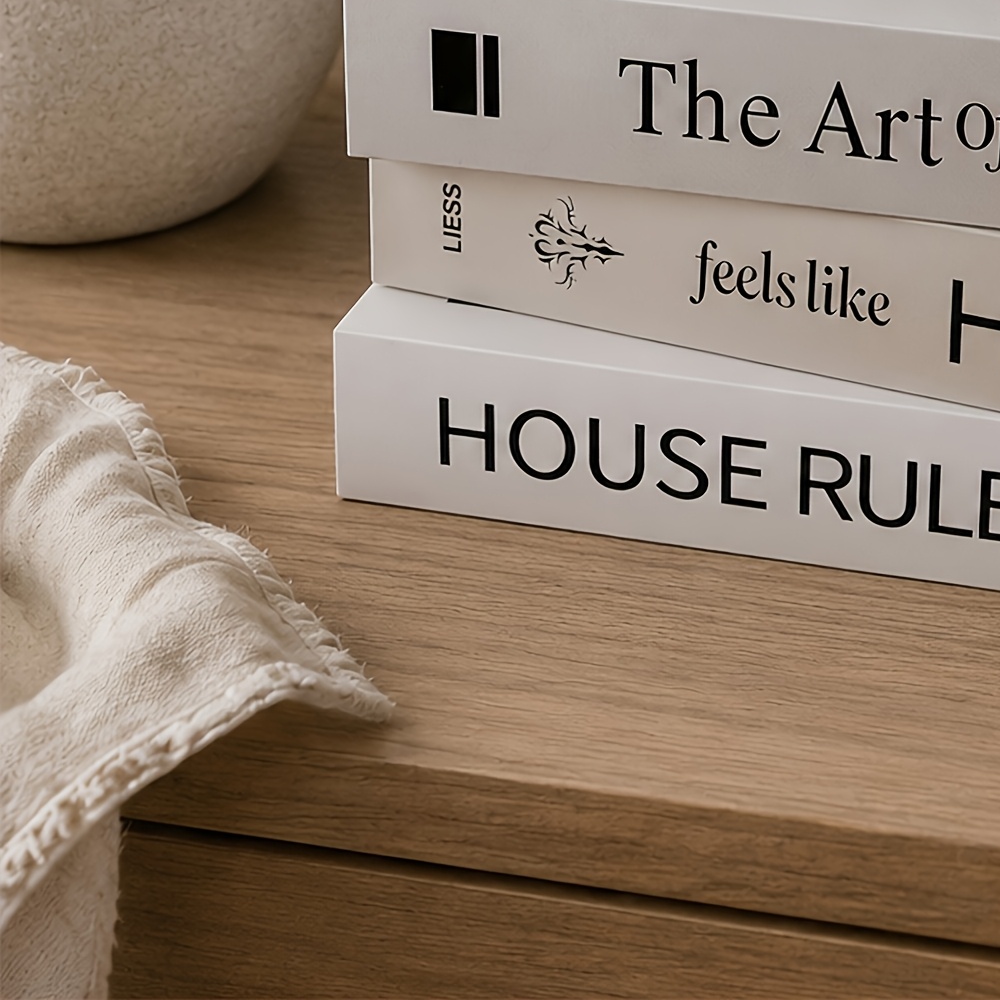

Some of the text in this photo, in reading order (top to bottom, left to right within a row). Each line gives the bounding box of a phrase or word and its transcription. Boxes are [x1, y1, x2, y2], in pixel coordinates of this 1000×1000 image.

[617, 57, 782, 149] The
[802, 79, 943, 168] Art
[442, 181, 462, 253] LIESS
[689, 239, 797, 310] feels
[805, 259, 892, 327] like
[437, 395, 769, 512] HOUSE
